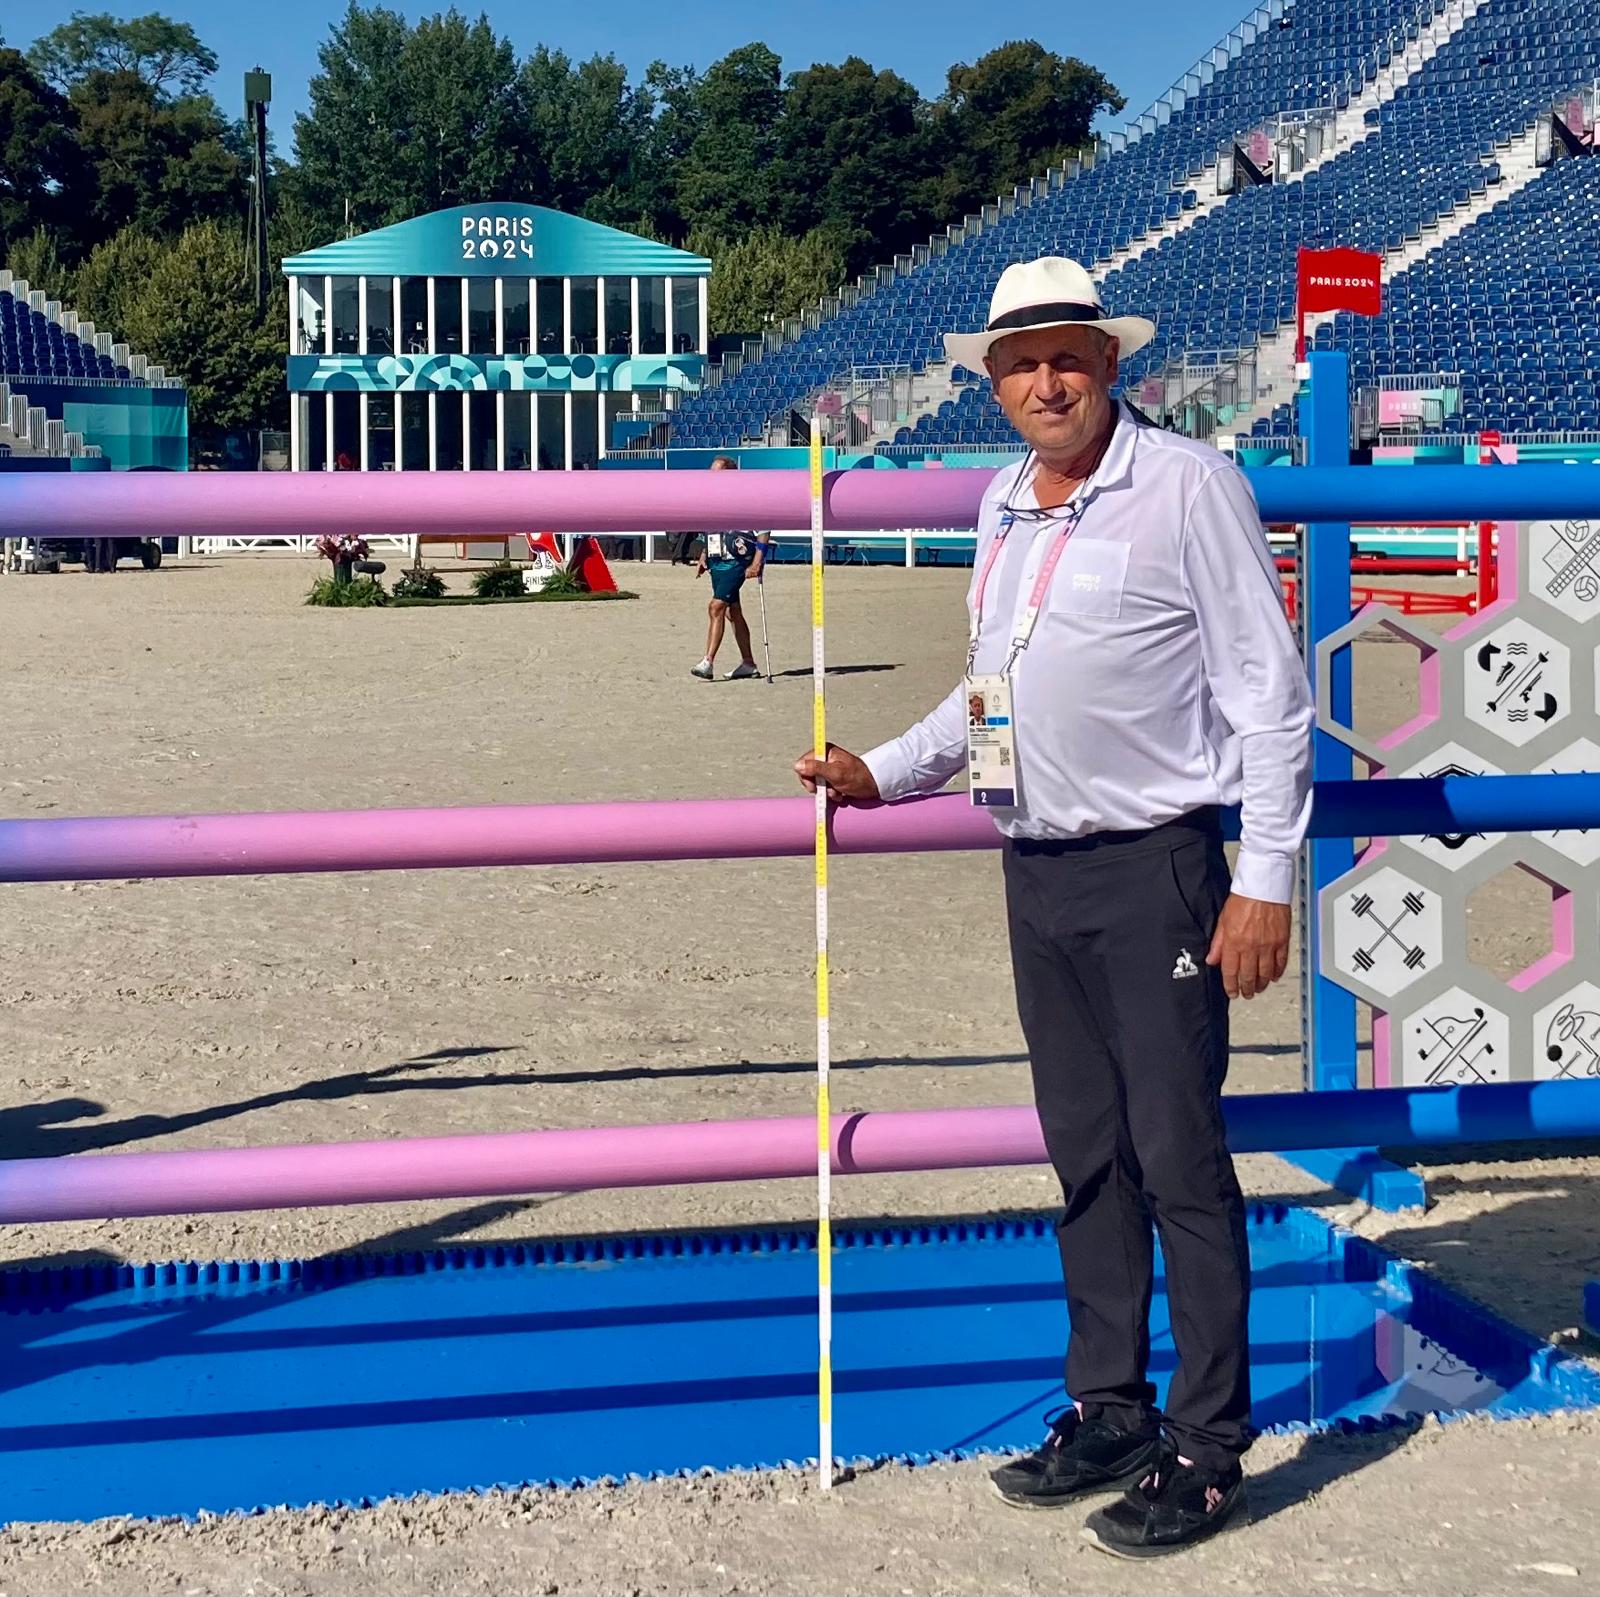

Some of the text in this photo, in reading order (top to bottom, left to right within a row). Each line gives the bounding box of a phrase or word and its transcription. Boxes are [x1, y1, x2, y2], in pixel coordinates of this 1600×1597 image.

[462, 239, 534, 259] 2024
[1344, 278, 1374, 288] 2024
[981, 791, 987, 803] 2
